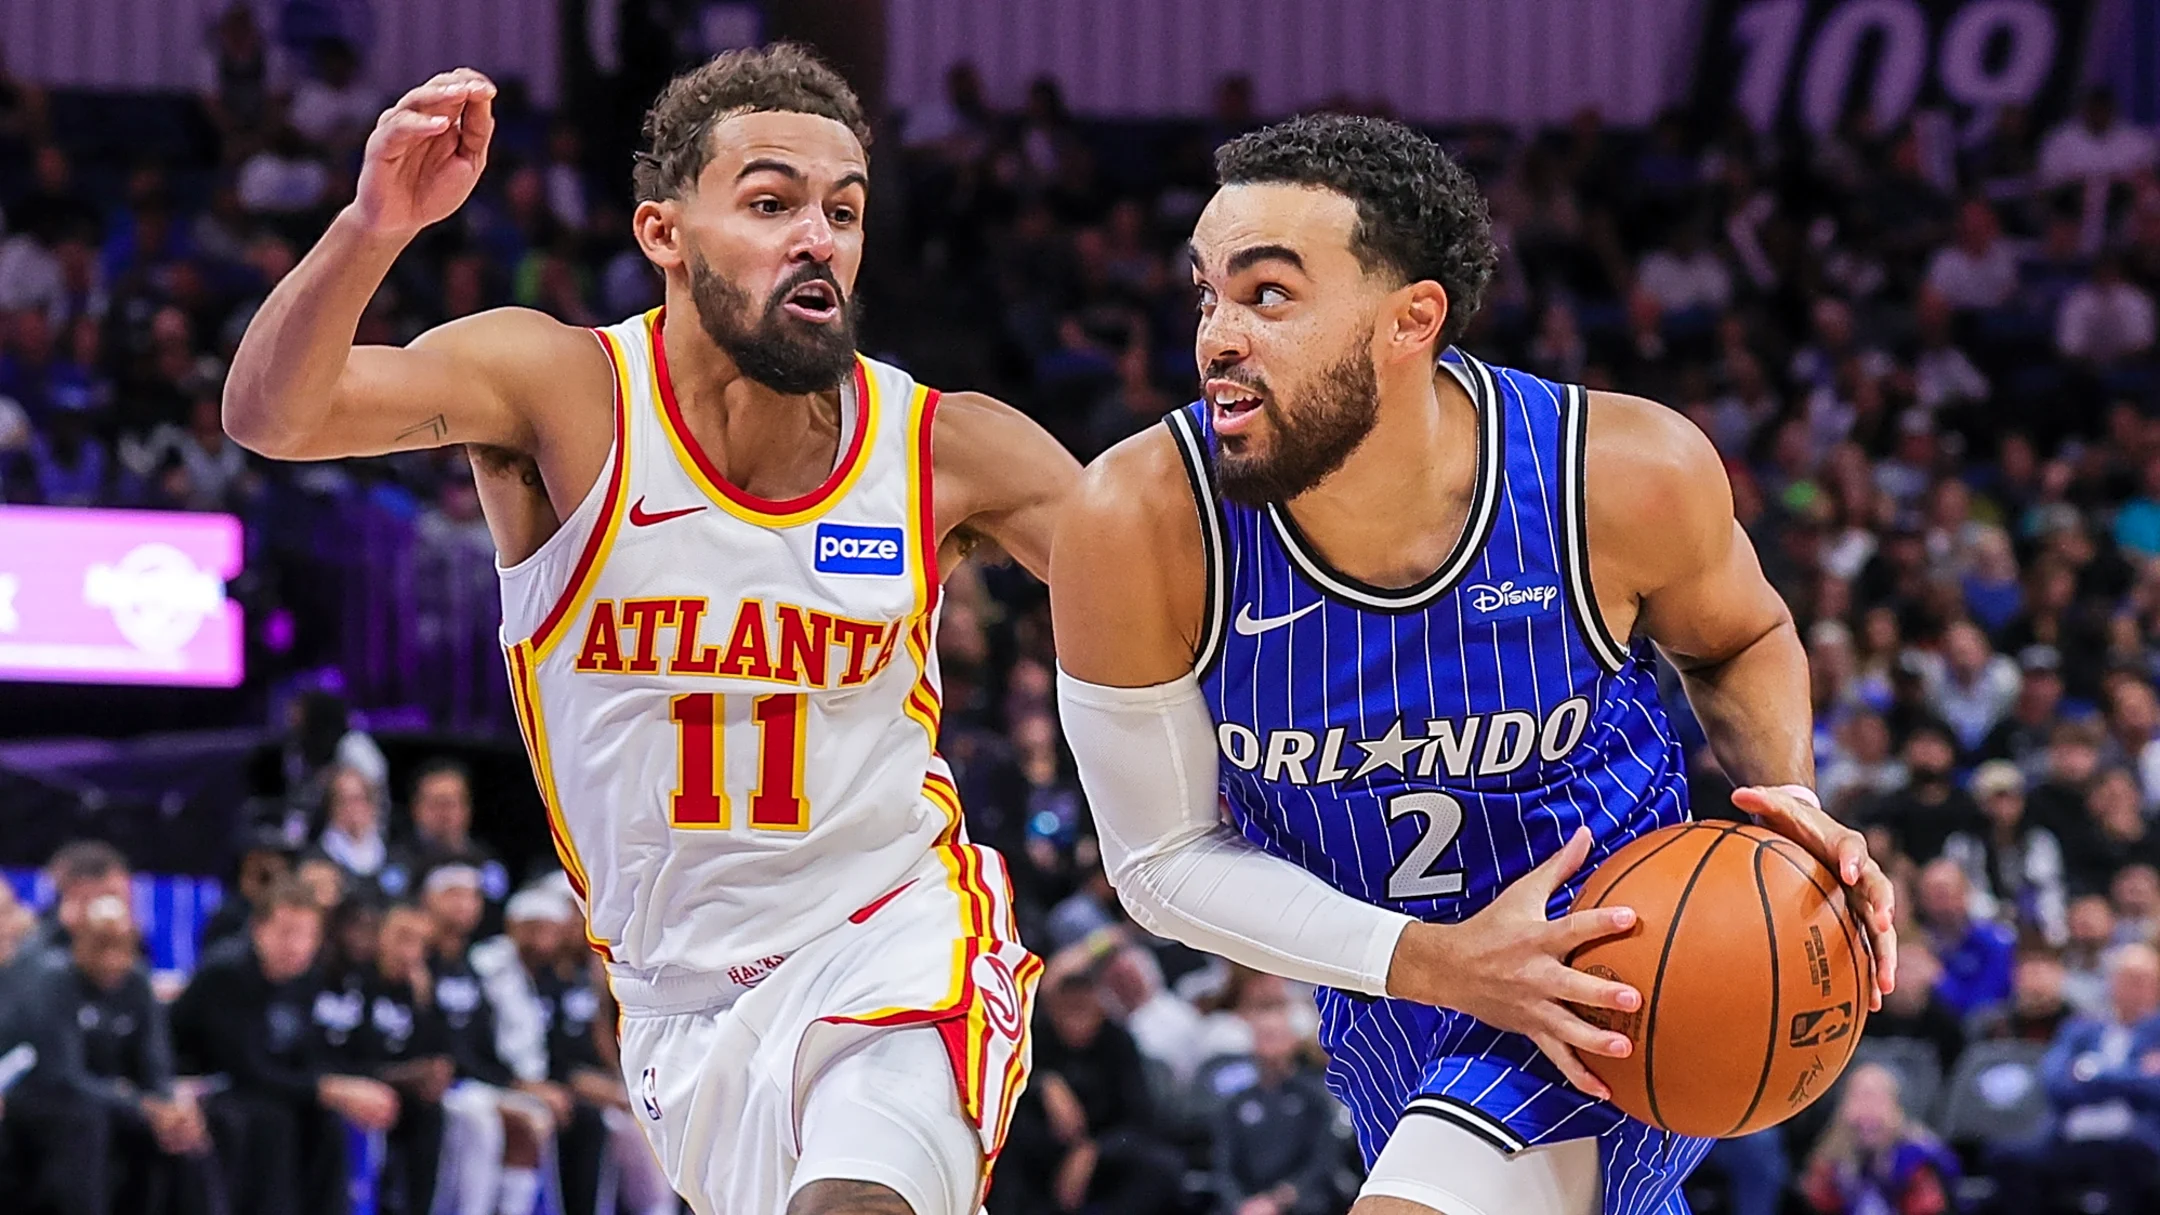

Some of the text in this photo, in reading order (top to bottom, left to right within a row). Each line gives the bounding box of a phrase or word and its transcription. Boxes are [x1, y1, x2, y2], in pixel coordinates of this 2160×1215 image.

[1730, 0, 2056, 148] 109
[820, 536, 899, 562] paze
[574, 596, 904, 689] ATLANTA
[668, 691, 811, 832] 11
[1387, 790, 1465, 900] 2
